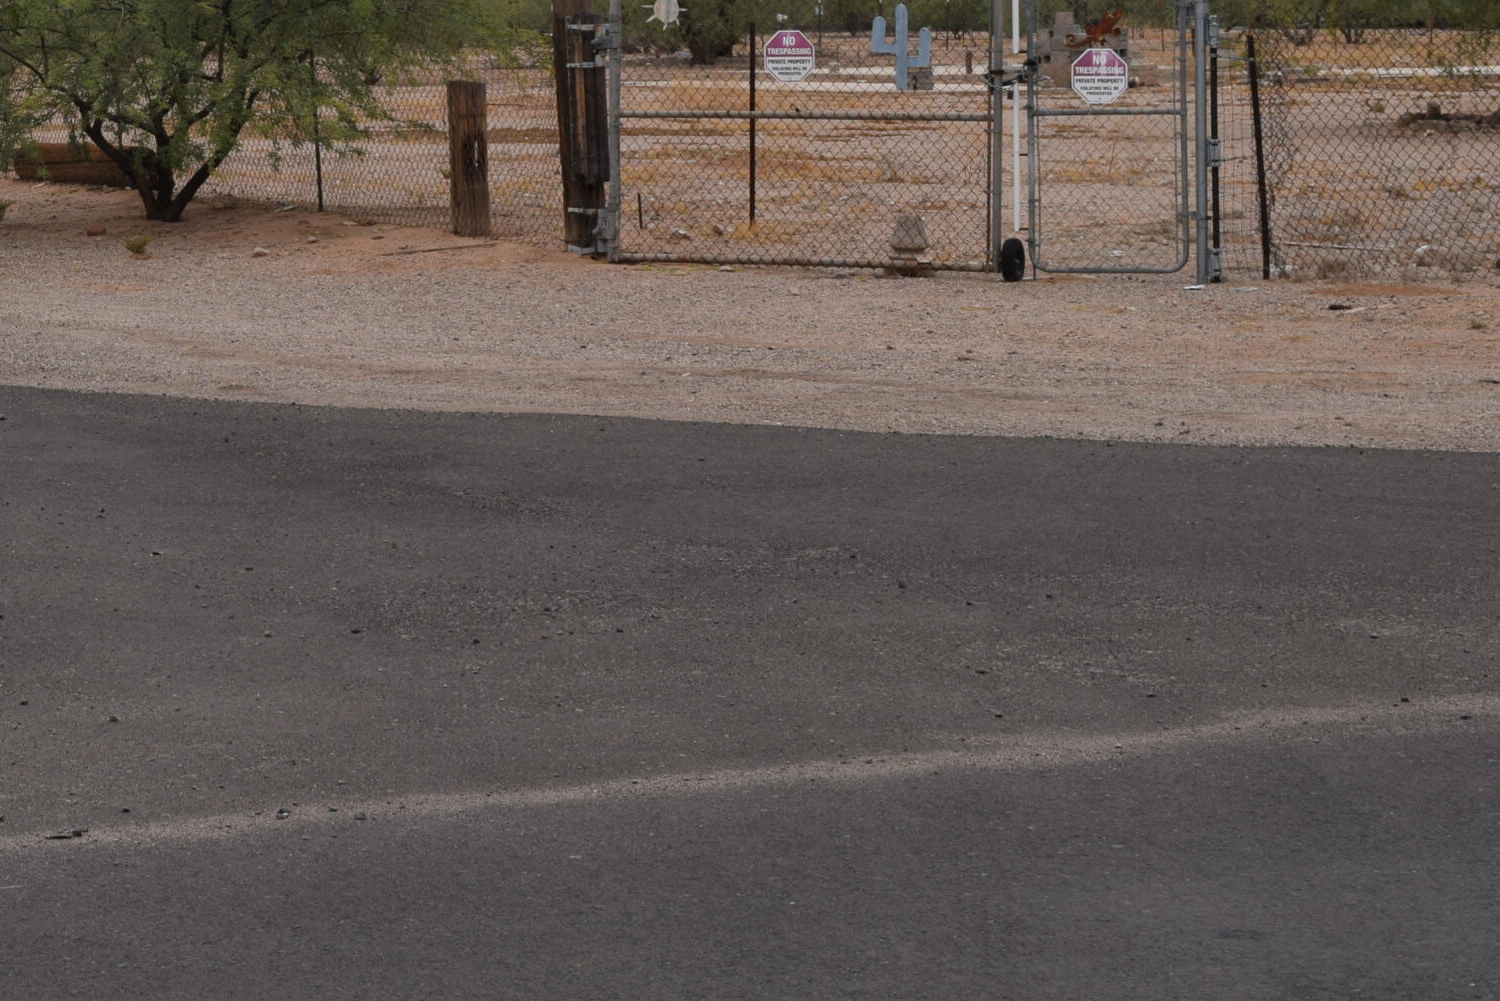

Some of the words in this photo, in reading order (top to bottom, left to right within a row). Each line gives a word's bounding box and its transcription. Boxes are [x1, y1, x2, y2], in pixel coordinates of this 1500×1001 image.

[782, 36, 796, 46] NO
[767, 47, 812, 55] TRESPASSING
[1092, 54, 1107, 65] NO
[1075, 66, 1124, 74] TRESPASSING
